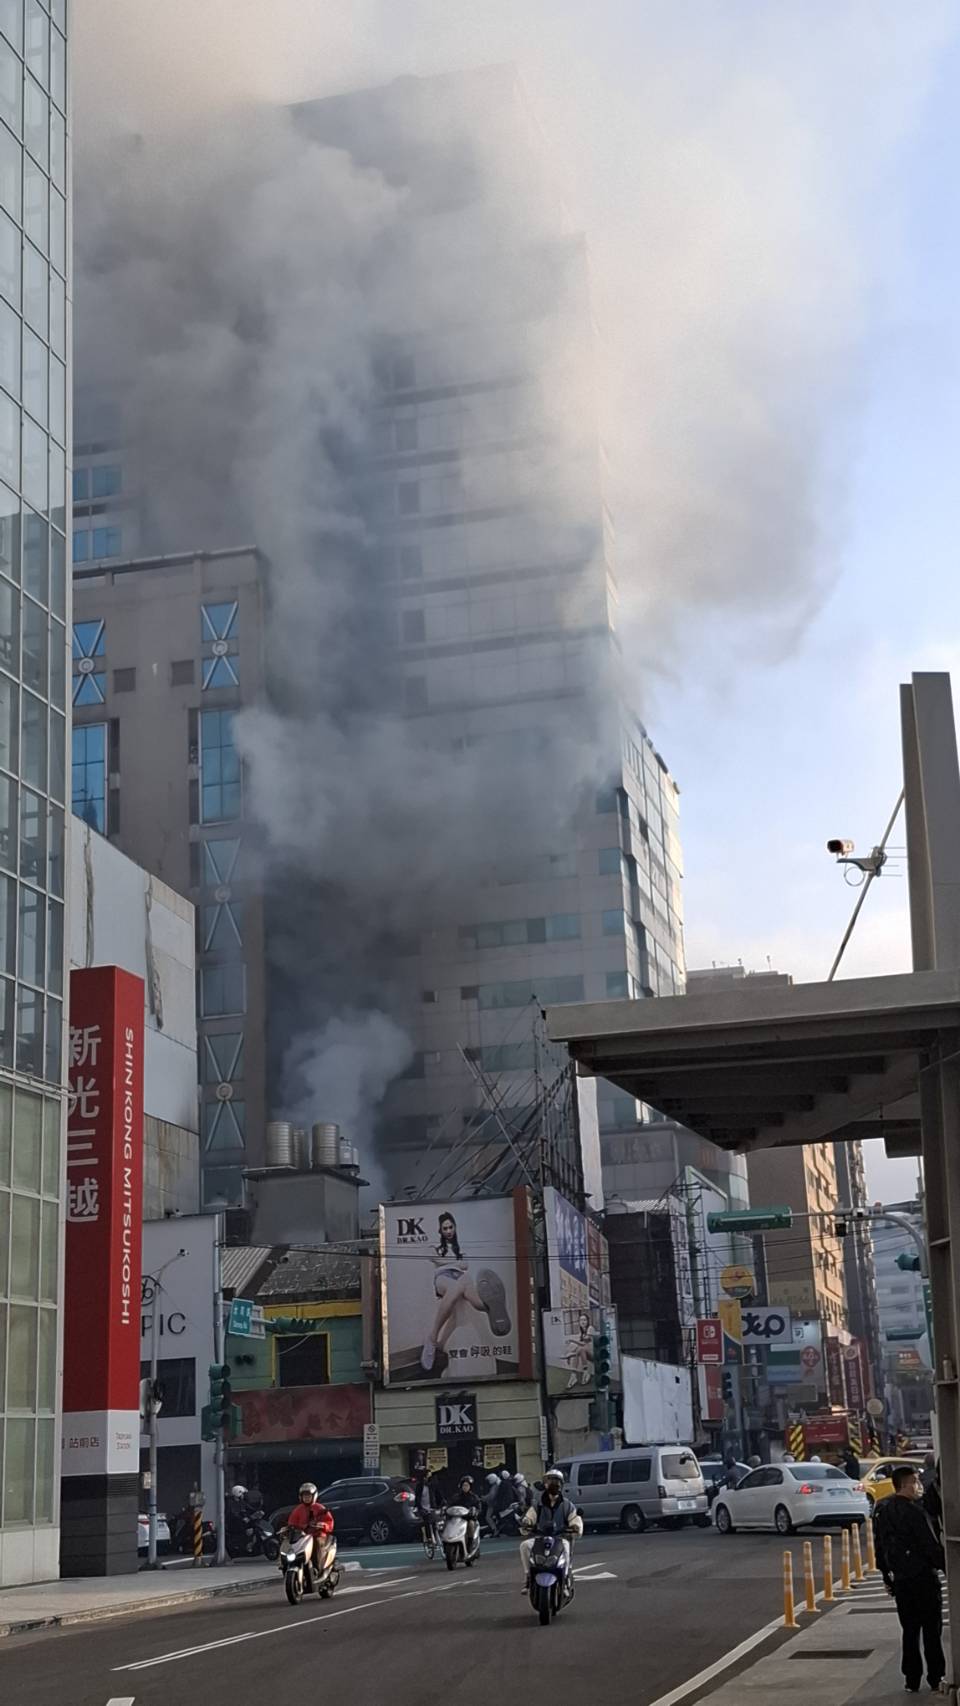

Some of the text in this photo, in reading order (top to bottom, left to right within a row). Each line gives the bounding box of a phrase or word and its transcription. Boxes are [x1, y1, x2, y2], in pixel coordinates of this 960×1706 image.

[67, 1025, 102, 1222] 新光三越
[121, 1027, 133, 1324] SHIN KONG MITSUKOSHI
[396, 1217, 425, 1236] DK
[438, 1404, 473, 1425] DK
[440, 1425, 474, 1434] DR.KAO
